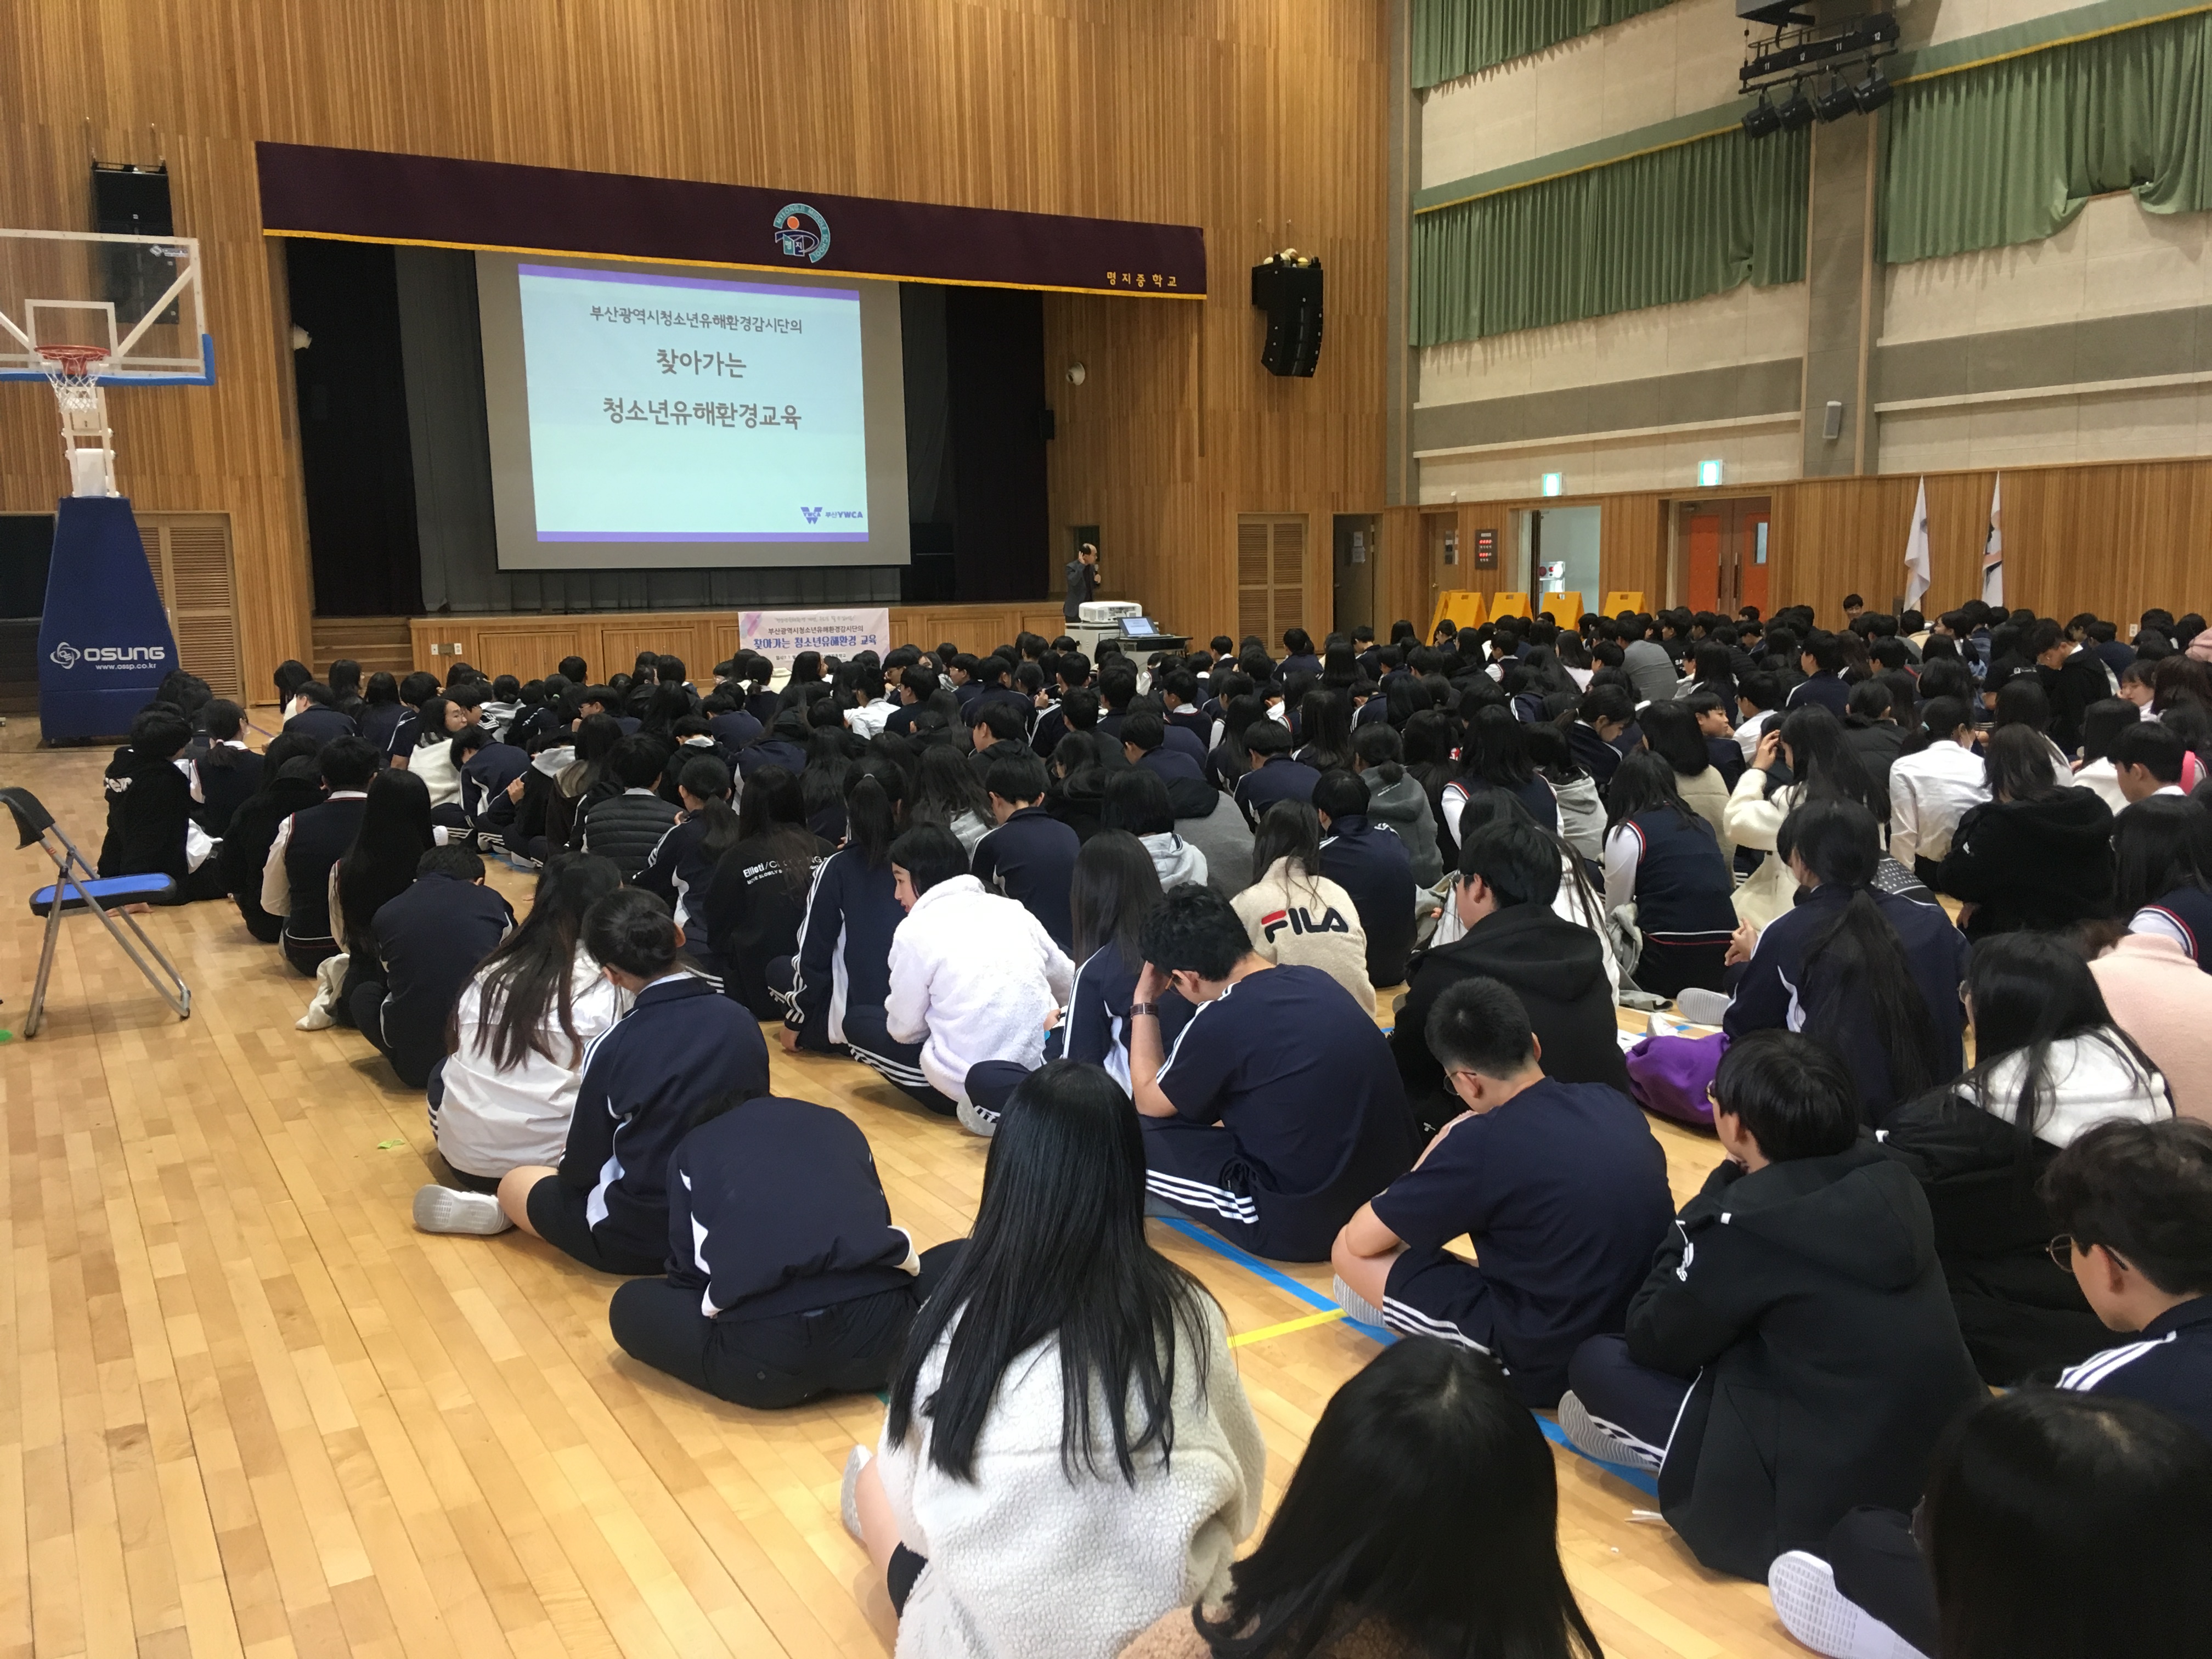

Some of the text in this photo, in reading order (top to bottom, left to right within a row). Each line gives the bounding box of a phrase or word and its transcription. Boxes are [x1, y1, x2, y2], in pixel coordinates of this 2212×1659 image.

[590, 305, 802, 334] 부산광역시청소년유해환경감시단의
[657, 348, 747, 378] 찾아가는
[603, 397, 802, 430] 청소년유해환경교육
[83, 646, 165, 662] OSUNG
[753, 634, 877, 650] 찾아가는 청소년유해환경 교육
[95, 662, 156, 670] www.ossp.co.kr
[1261, 907, 1349, 944] FILA
